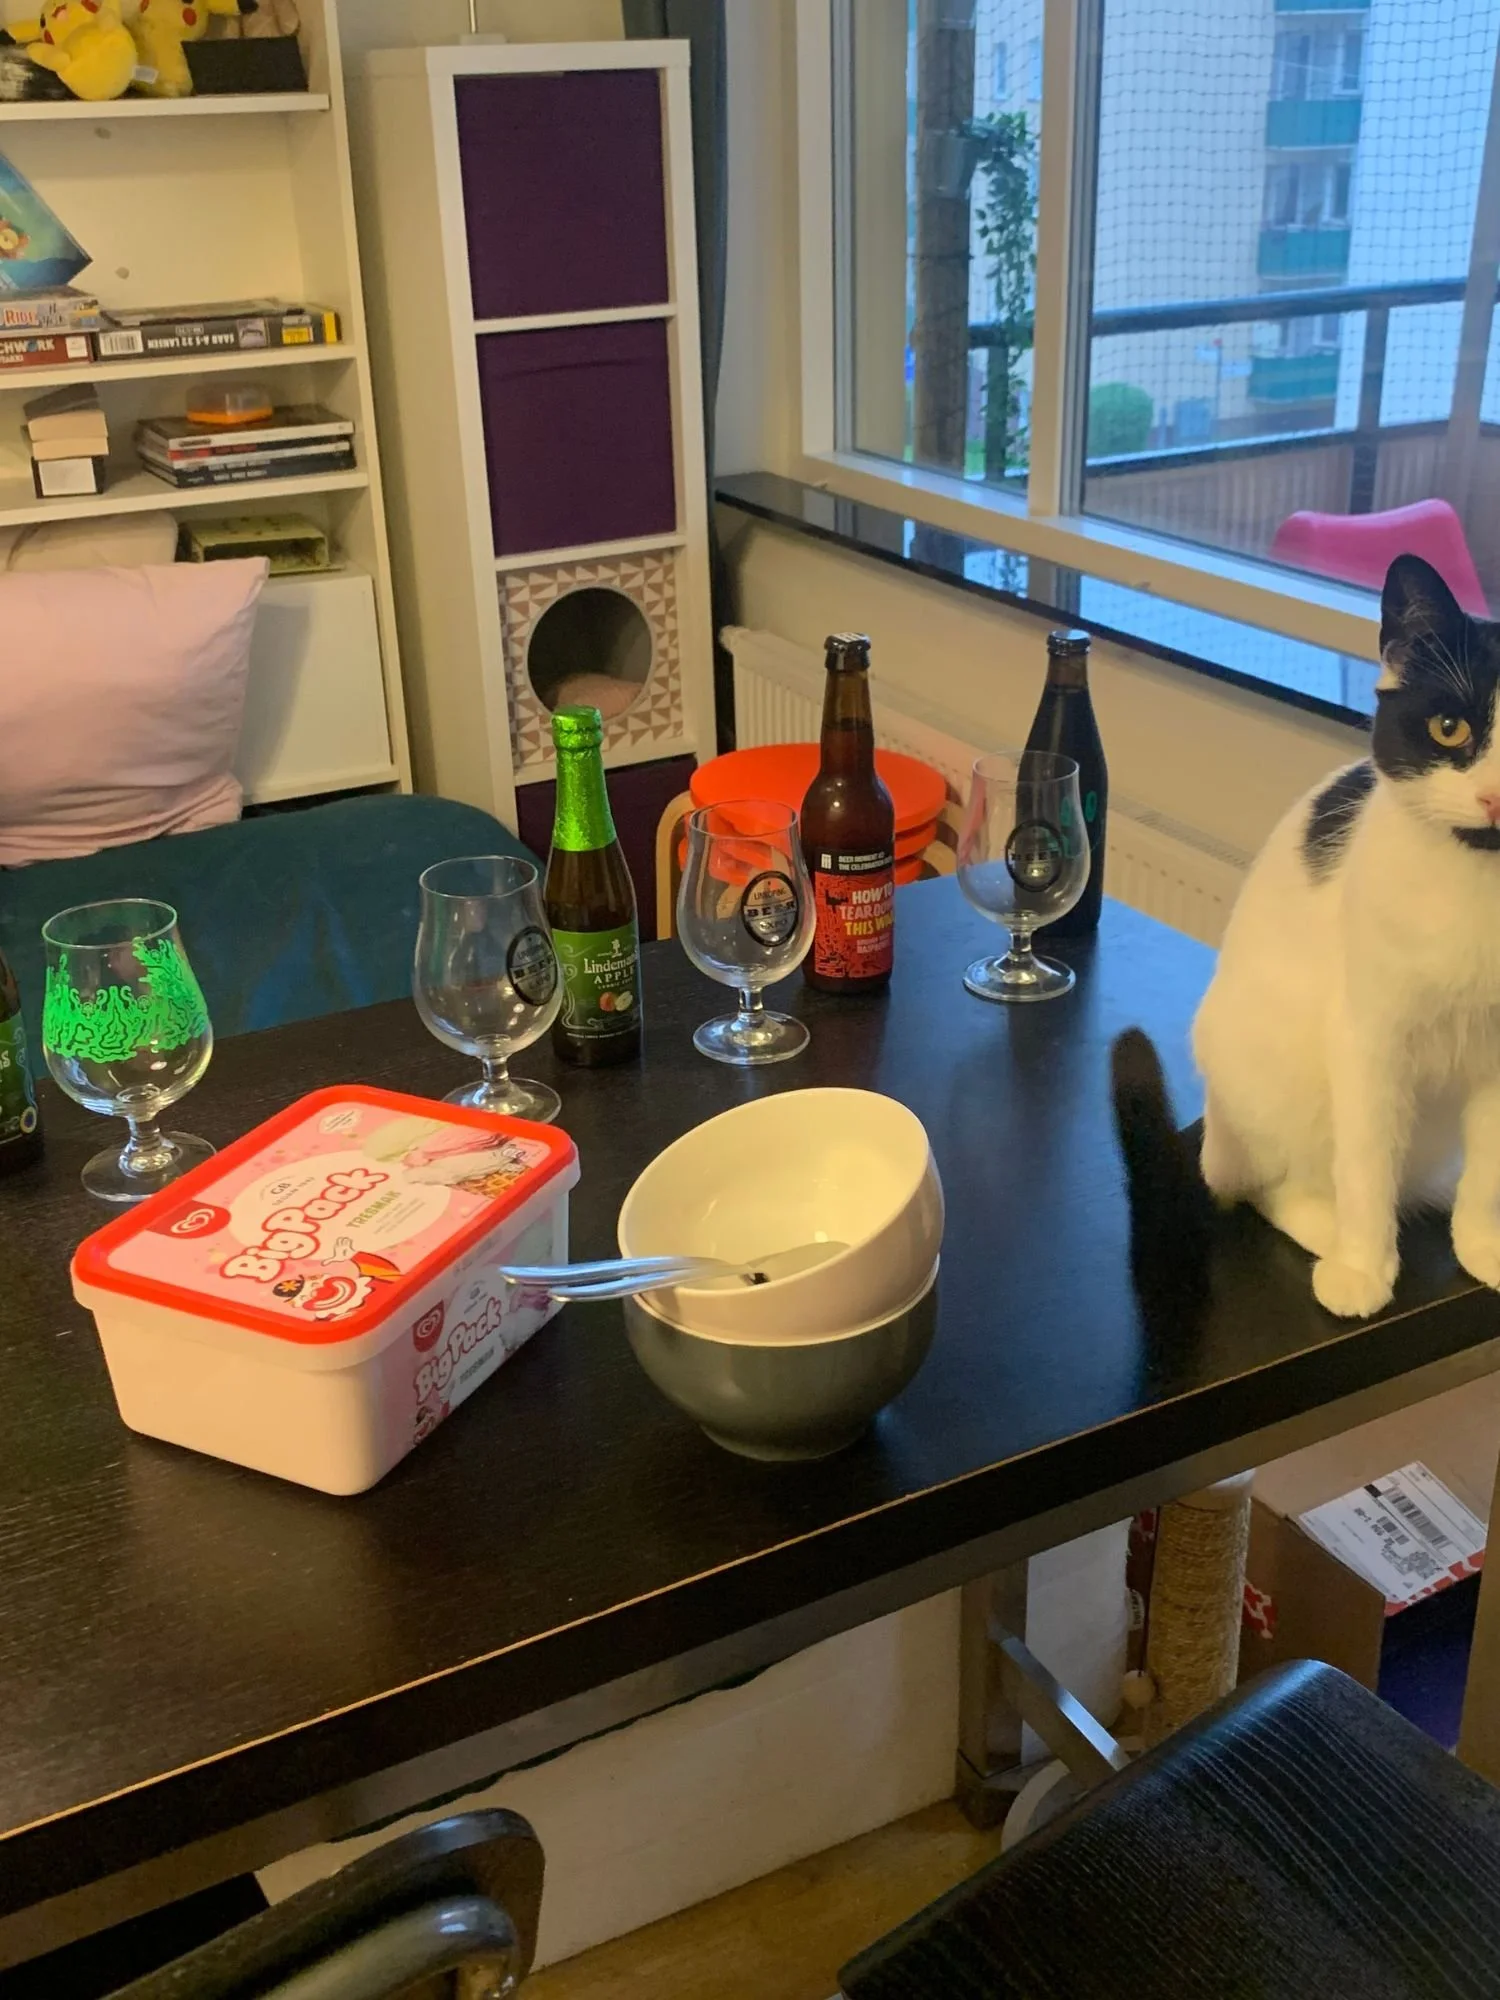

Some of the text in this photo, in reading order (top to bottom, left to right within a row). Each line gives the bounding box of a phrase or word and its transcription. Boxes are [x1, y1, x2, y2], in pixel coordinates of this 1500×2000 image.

[852, 886, 882, 905] HOW
[746, 900, 796, 918] BEER
[839, 903, 873, 921] TEAR
[845, 920, 874, 936] THIS
[270, 1183, 292, 1195] GB
